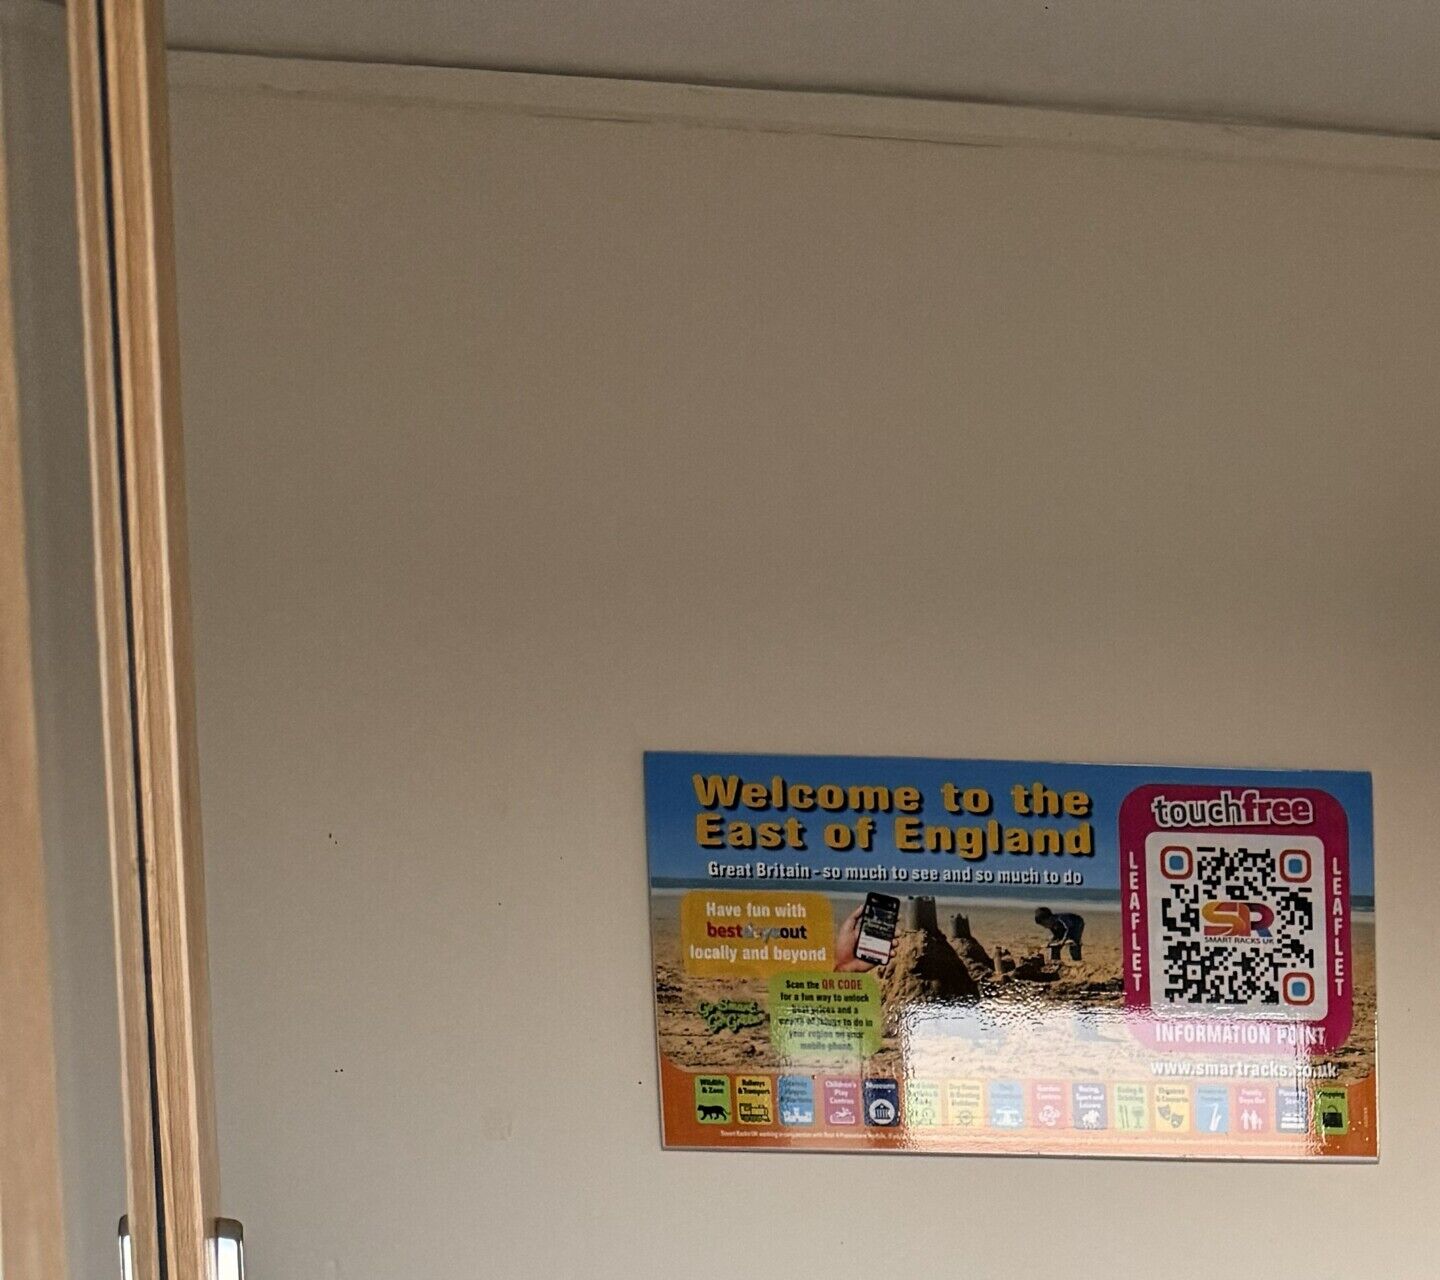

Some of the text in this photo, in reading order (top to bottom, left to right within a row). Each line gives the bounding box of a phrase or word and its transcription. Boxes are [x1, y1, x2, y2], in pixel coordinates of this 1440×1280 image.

[692, 773, 1091, 816] Welcome to the
[1152, 790, 1314, 827] touchfree
[695, 811, 1093, 861] East of England
[708, 860, 752, 877] Great
[756, 862, 810, 879] Britain
[823, 867, 841, 880] so
[845, 865, 888, 880] much
[891, 866, 908, 880] to
[911, 868, 938, 881] see
[943, 867, 972, 882] and
[976, 870, 994, 883] so
[998, 868, 1039, 884] much
[1044, 870, 1060, 885] to
[1064, 870, 1082, 885] do
[706, 902, 807, 918] Have fun with
[1129, 851, 1142, 992] LEAFLET
[1333, 857, 1344, 996] LEAFLET
[690, 944, 827, 963] locally and beyond
[785, 979, 863, 990] Scan the QR CODE
[780, 992, 792, 1001] for
[801, 992, 814, 1001] fun
[816, 995, 831, 1004] way
[834, 993, 842, 1002] to
[853, 1019, 864, 1027] do
[1156, 1024, 1326, 1046] INFORMATION POINT
